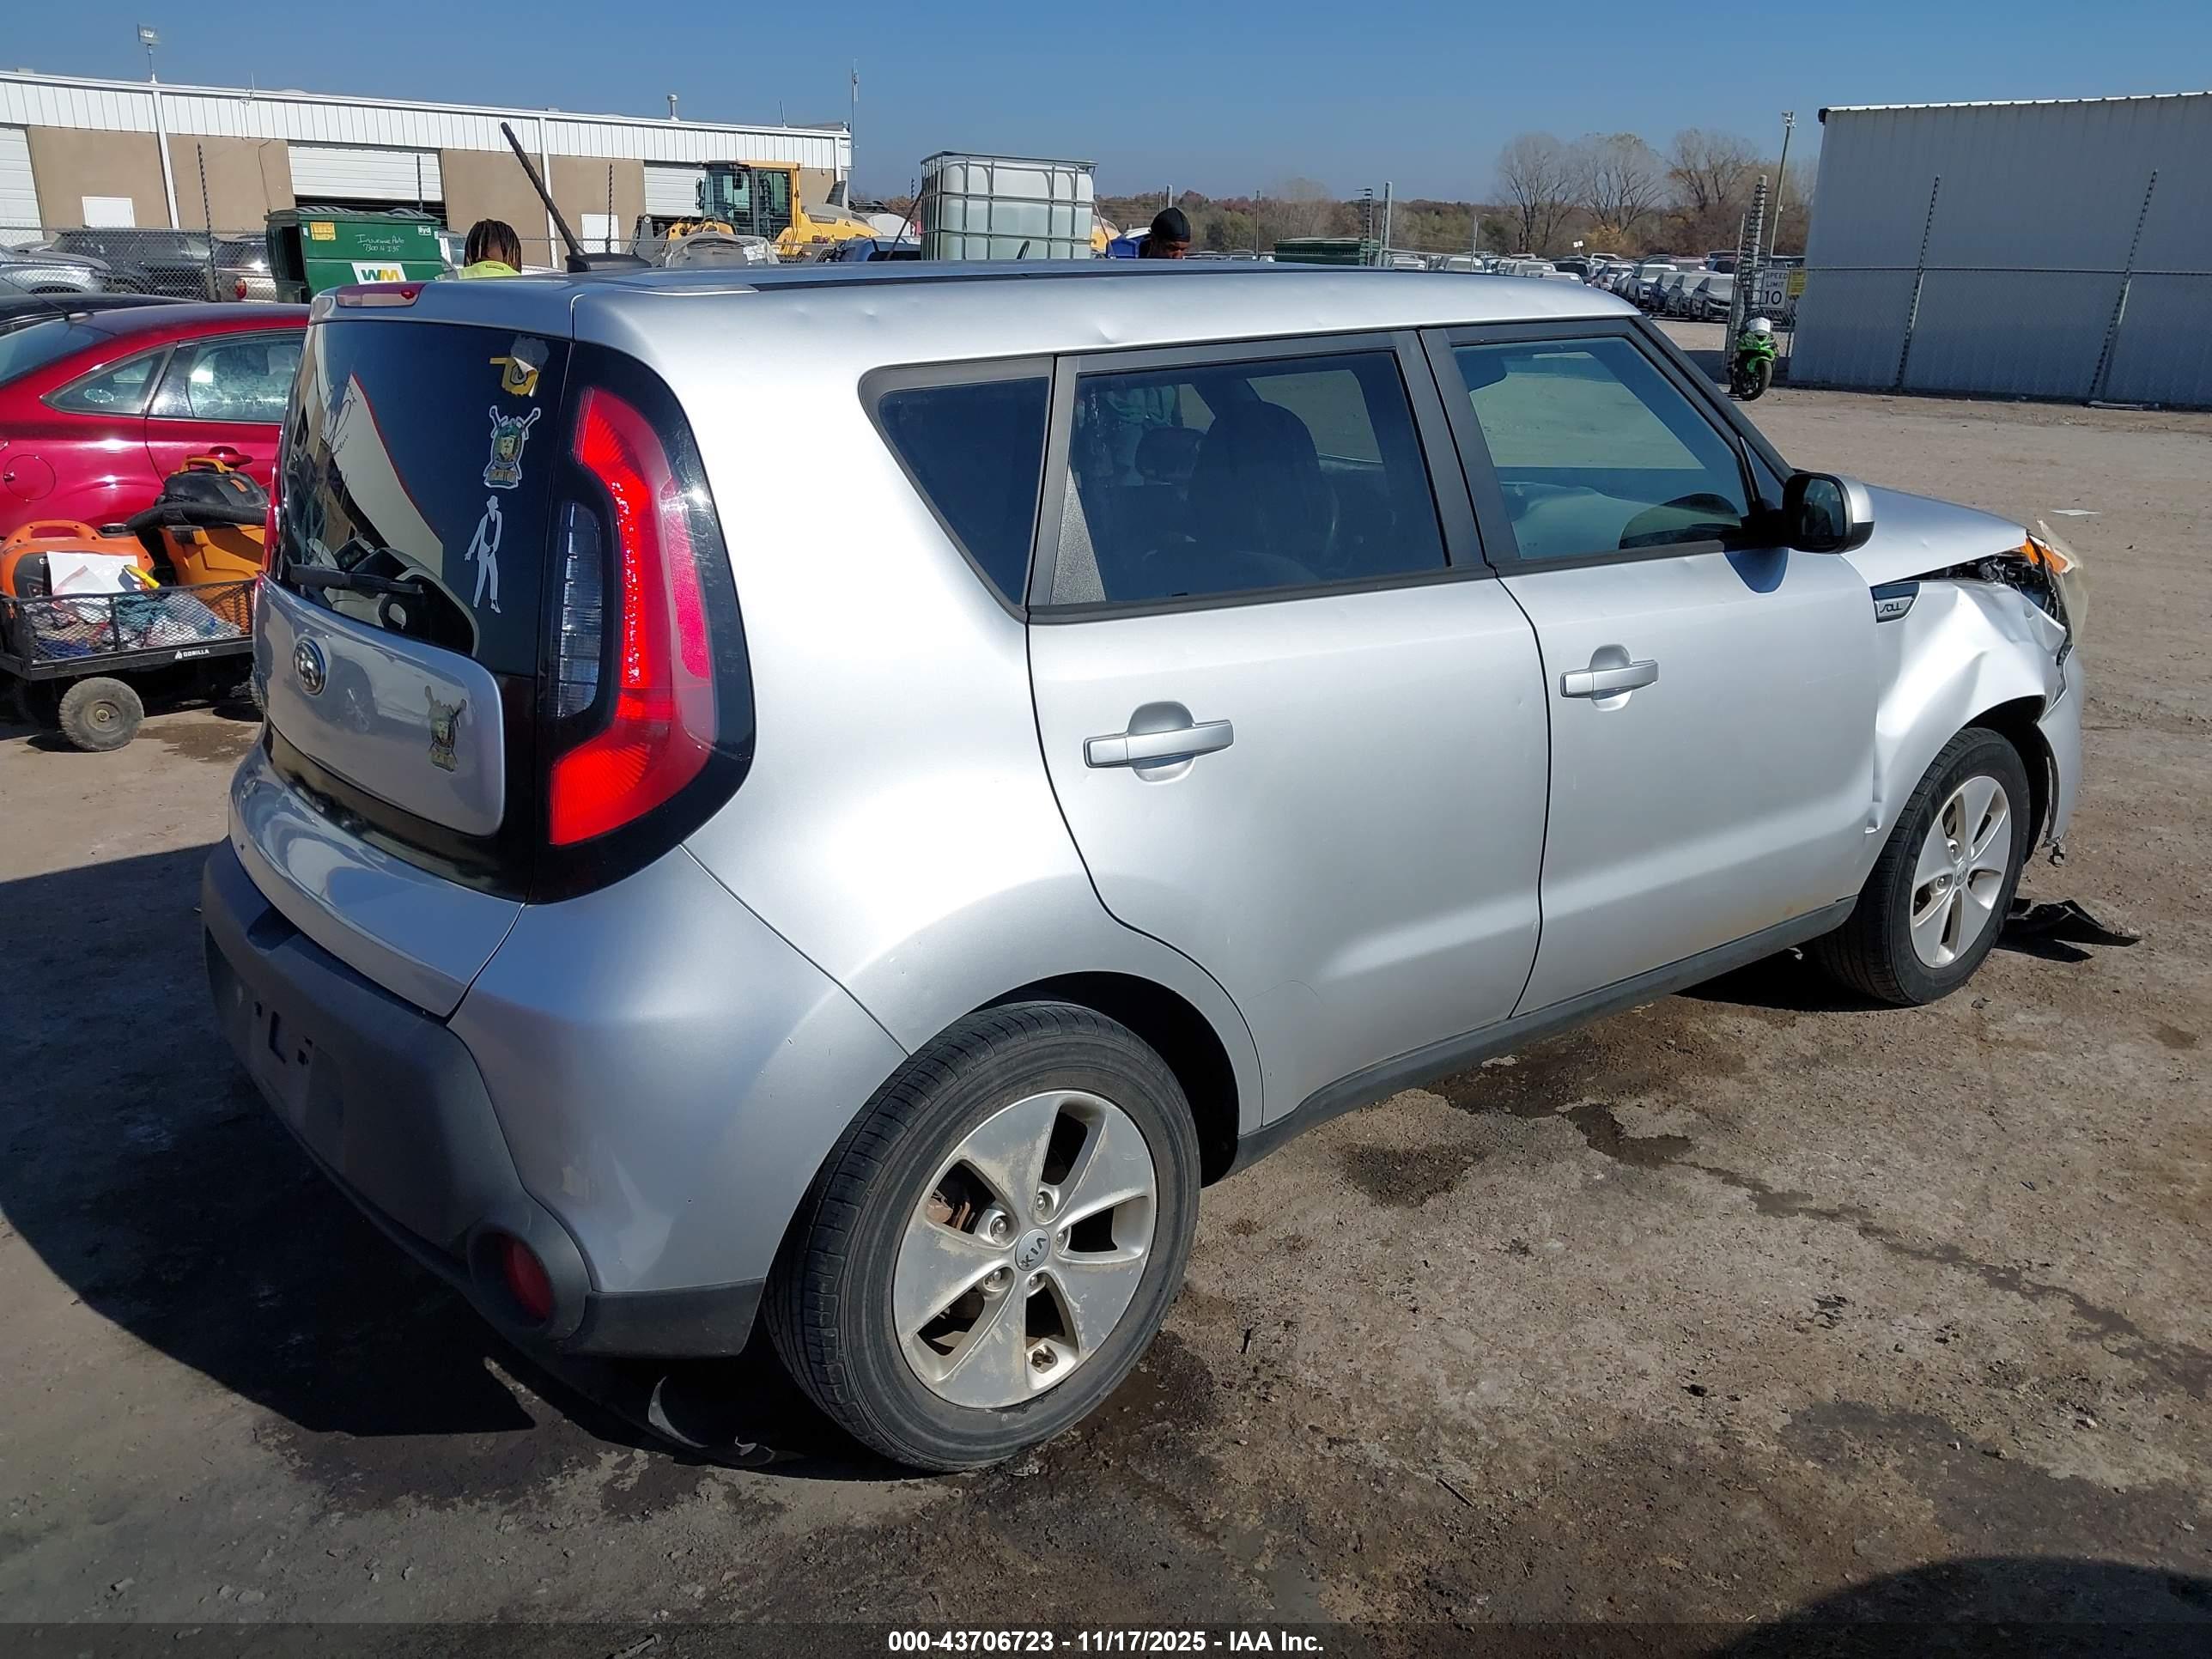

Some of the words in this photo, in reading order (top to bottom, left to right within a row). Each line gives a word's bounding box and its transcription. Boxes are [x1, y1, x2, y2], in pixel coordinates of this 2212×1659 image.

[361, 268, 400, 281] WM
[1765, 271, 1788, 280] SPEED
[1765, 290, 1783, 306] 10
[183, 648, 210, 658] GORILLA
[1020, 1237, 1047, 1267] KIA
